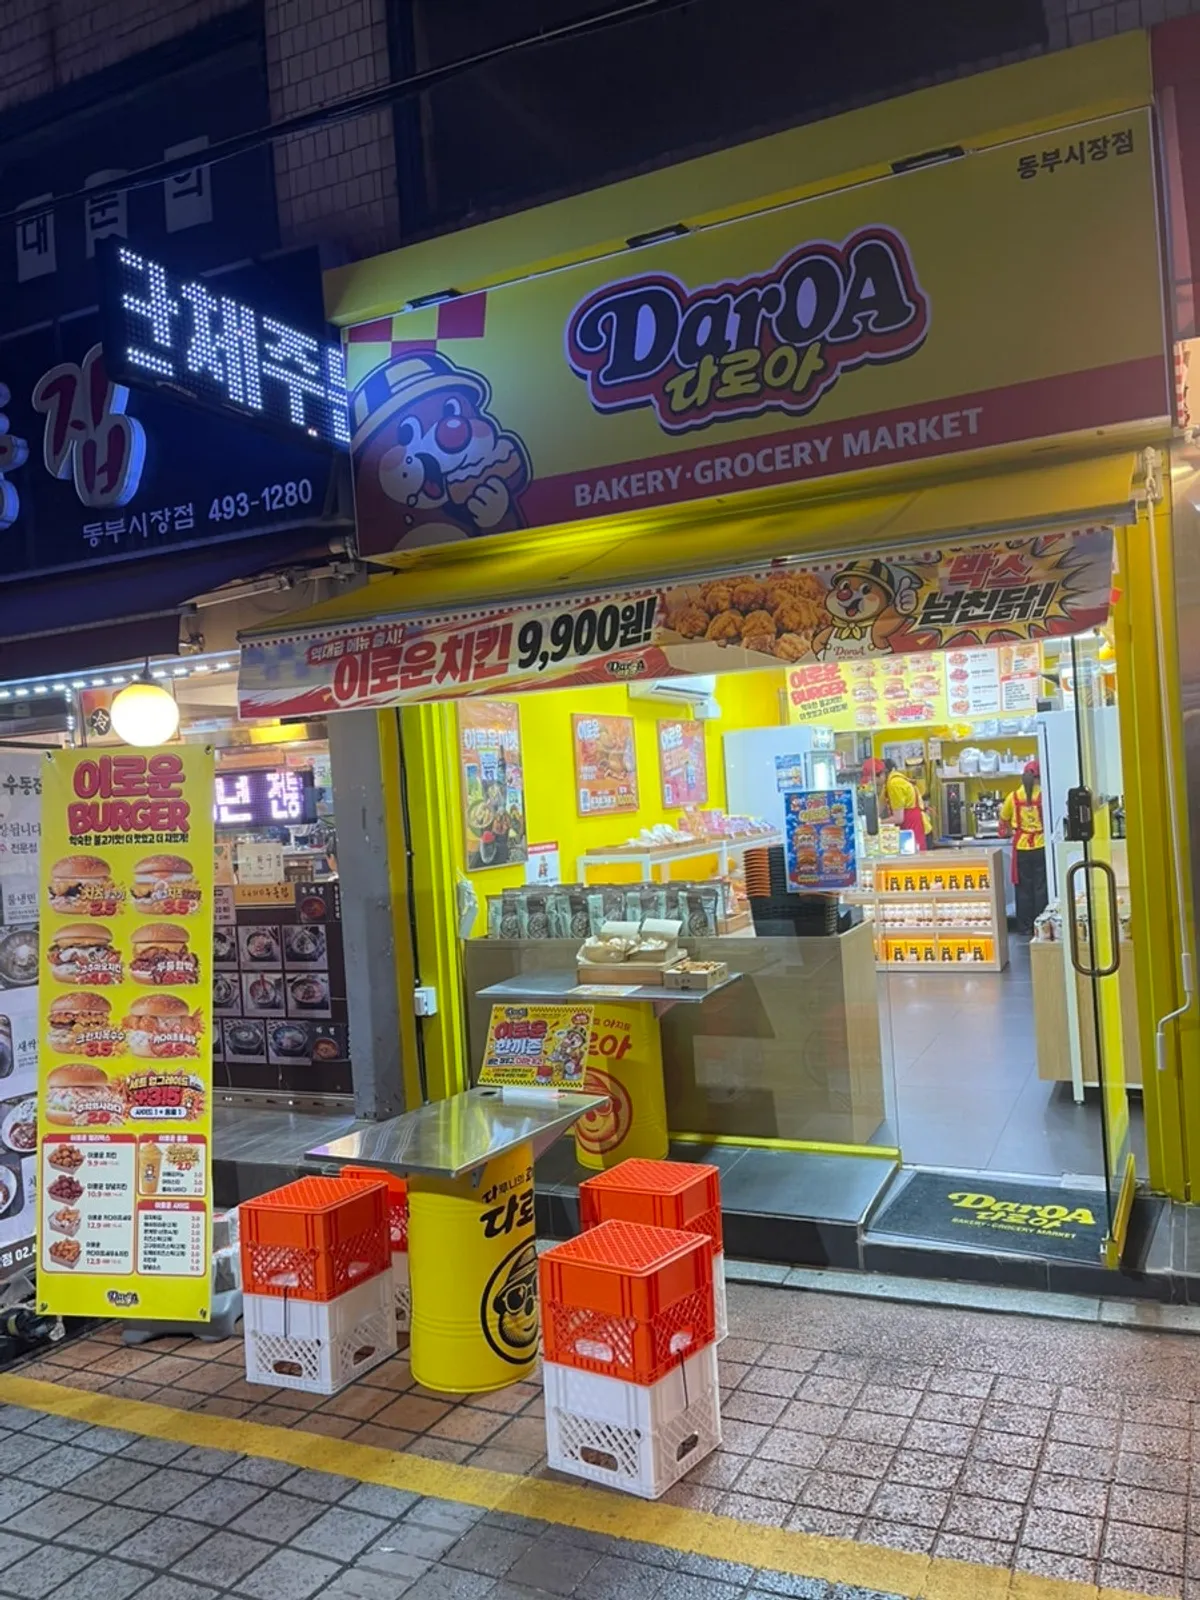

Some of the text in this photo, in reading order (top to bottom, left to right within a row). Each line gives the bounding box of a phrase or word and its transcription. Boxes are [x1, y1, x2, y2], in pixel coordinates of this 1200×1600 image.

[1017, 129, 1134, 179] 동부시장점
[574, 238, 917, 386] DarOA
[666, 342, 826, 413] 다로아
[842, 406, 984, 460] MARKET
[82, 478, 313, 547] 동부시장점 493-1280
[948, 552, 1032, 588] 박스
[517, 595, 659, 672] 9,900원!
[791, 679, 848, 706] BURGER
[73, 753, 186, 799] 이로운
[68, 799, 191, 836] BURGER
[948, 1192, 1096, 1225] DarOA
[976, 1211, 1062, 1229] 다로아
[1036, 1228, 1077, 1240] MARKET
